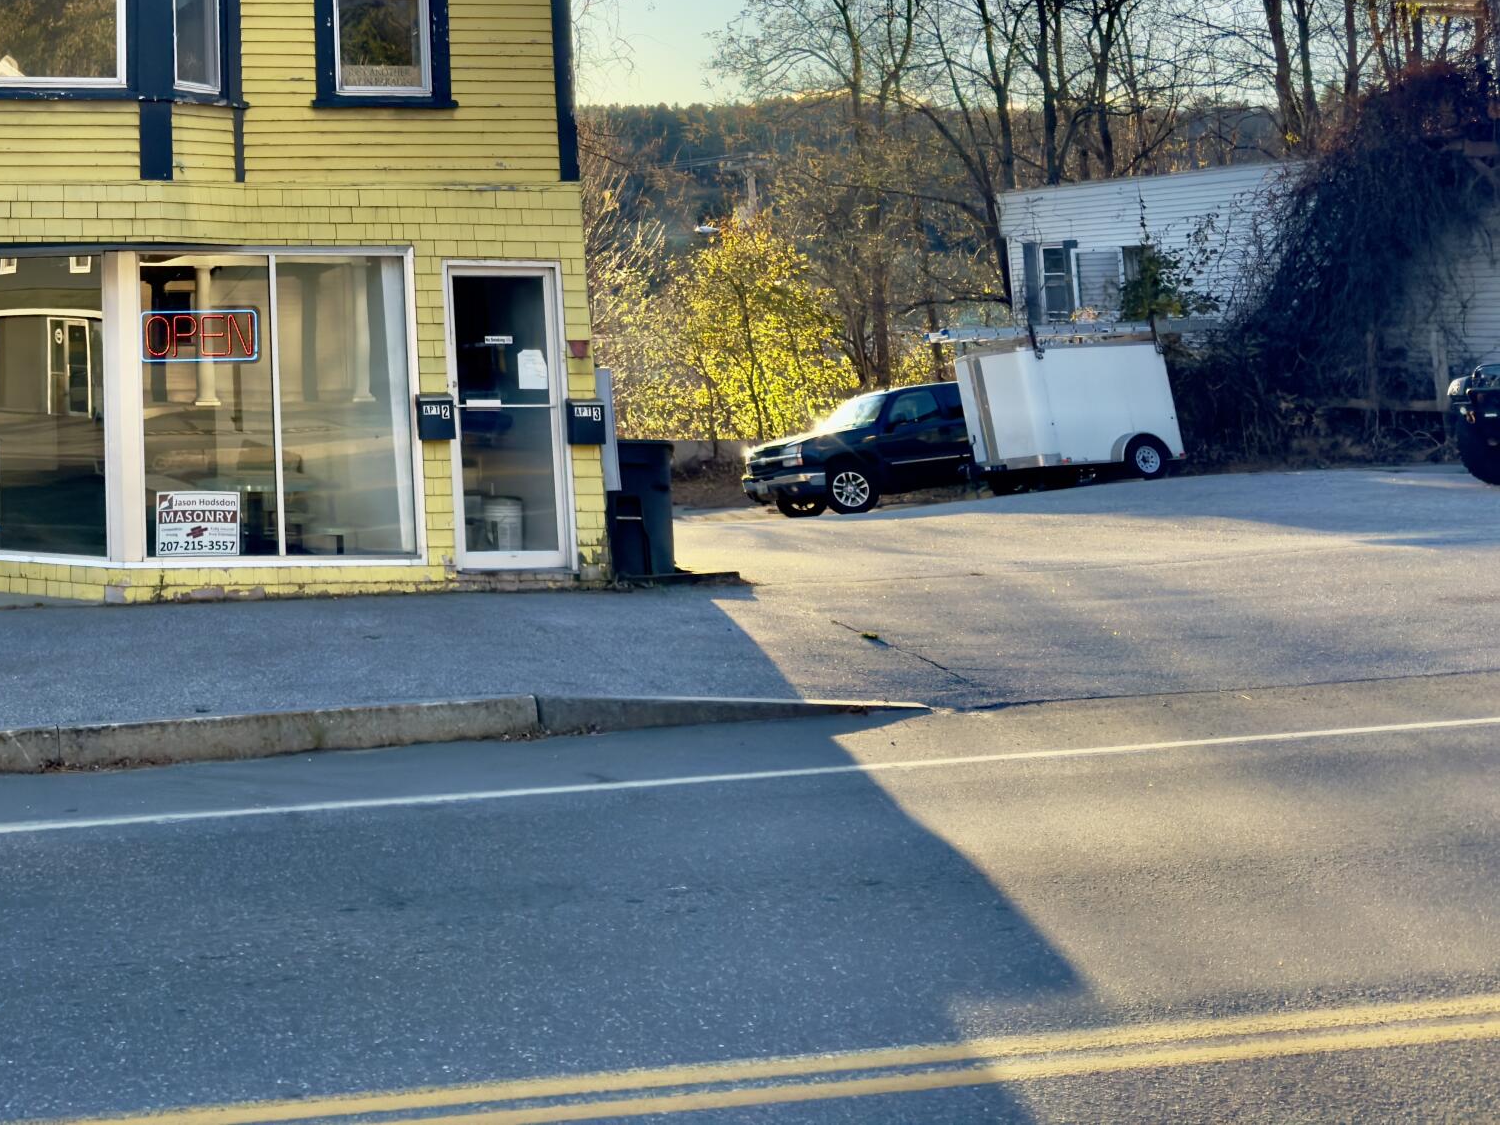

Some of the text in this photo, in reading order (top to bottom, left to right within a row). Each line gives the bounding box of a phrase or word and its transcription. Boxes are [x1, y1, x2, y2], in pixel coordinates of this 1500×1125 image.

[145, 314, 252, 357] OPEN
[424, 405, 449, 418] APT 2
[575, 407, 600, 420] APT 3
[174, 498, 236, 507] Jason Hodsdon
[161, 510, 234, 523] MASONRY
[160, 540, 236, 552] 207-215-3557
